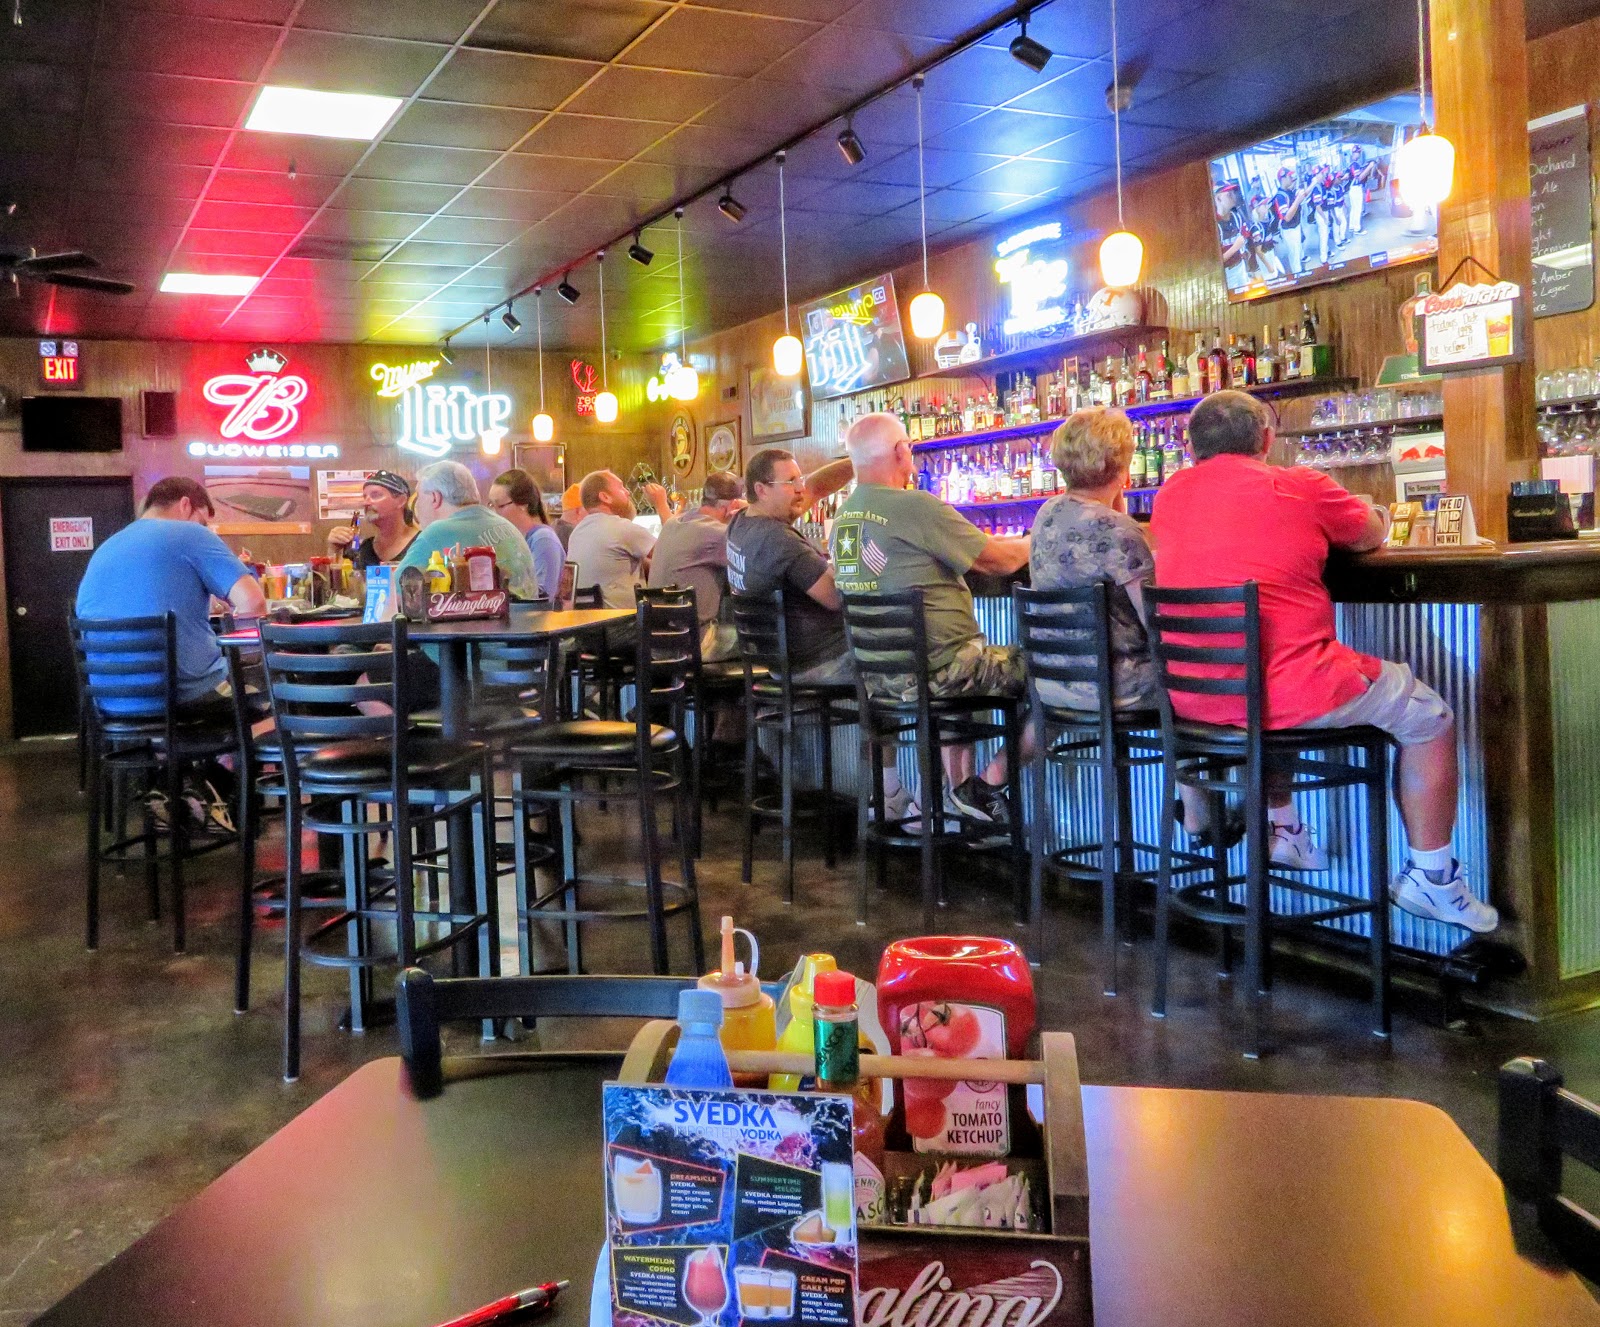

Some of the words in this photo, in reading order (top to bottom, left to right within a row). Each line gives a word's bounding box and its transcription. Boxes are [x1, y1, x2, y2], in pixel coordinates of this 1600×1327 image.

[1541, 181, 1559, 194] Ale
[1540, 269, 1574, 284] Amber
[1464, 285, 1513, 307] LIGHT
[44, 357, 76, 380] EXIT
[577, 404, 598, 412] STA
[187, 441, 340, 458] BUDWEISER
[1440, 499, 1452, 509] WE
[52, 521, 91, 533] EMERGENCY
[55, 536, 70, 549] EXIT
[72, 536, 90, 548] ONLY
[1446, 534, 1459, 543] WAY
[845, 581, 878, 592] STRONG
[428, 591, 506, 618] Yuengling
[975, 1099, 1001, 1112] fancy
[673, 1100, 778, 1128] SVEDKA
[952, 1112, 1003, 1127] TOMATO
[740, 1128, 783, 1140] VODKA
[947, 1129, 1003, 1144] KETCHUP
[623, 1255, 676, 1265] WATERMELON
[630, 1271, 656, 1279] SVEDKA
[649, 1265, 676, 1273] COSMO
[800, 1275, 829, 1284] CREAM
[800, 1284, 823, 1292] CAKE
[823, 1286, 845, 1294] SHOT
[801, 1291, 829, 1300] SVEDKA
